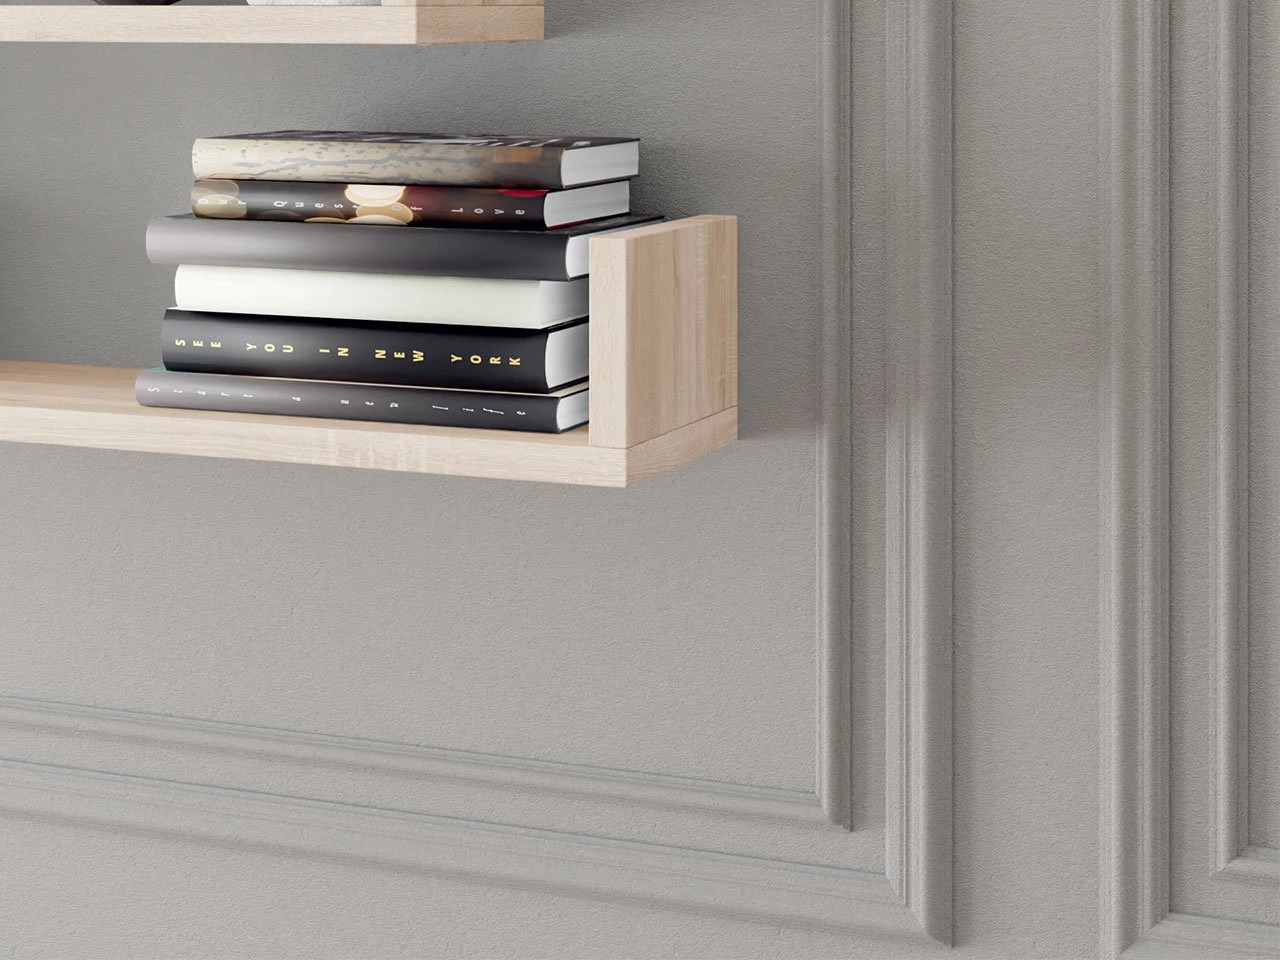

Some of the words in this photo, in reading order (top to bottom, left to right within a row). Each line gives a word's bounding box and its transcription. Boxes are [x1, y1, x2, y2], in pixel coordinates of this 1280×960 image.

[451, 207, 526, 215] Love
[175, 339, 222, 349] SEE
[246, 343, 294, 353] YOU
[319, 347, 349, 357] IN
[375, 349, 425, 362] NEW
[451, 354, 521, 366] YORK
